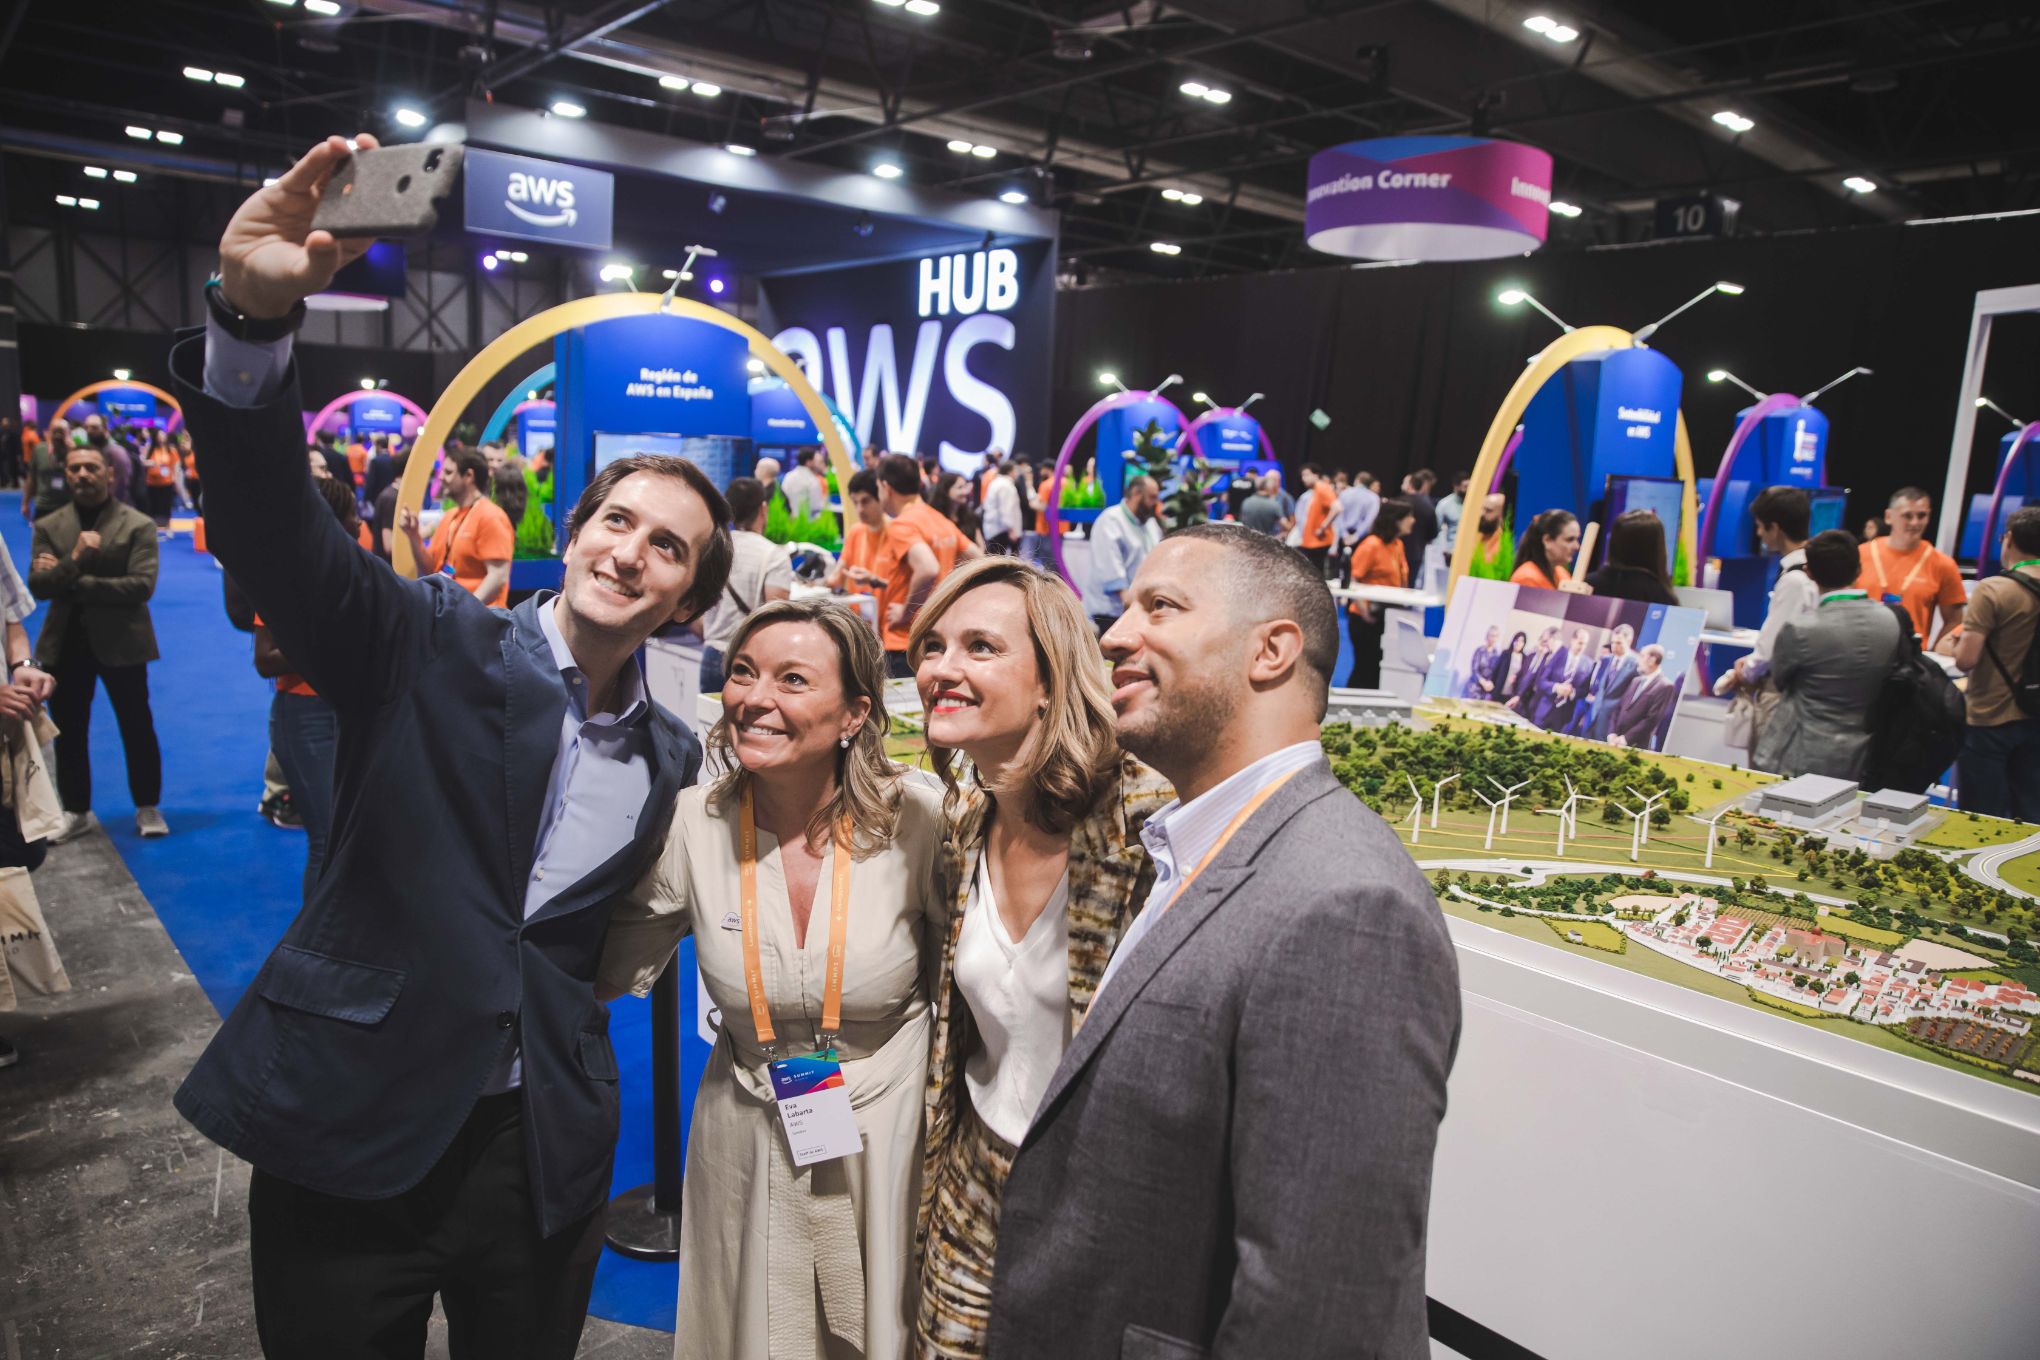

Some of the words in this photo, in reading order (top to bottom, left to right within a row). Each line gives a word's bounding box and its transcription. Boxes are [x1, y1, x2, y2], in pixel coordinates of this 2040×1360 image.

[507, 171, 576, 209] aws
[1377, 170, 1452, 190] Corner
[1672, 204, 1705, 233] 10
[918, 248, 1019, 317] HUB
[626, 383, 654, 399] AWS
[787, 1108, 813, 1119] Labarta
